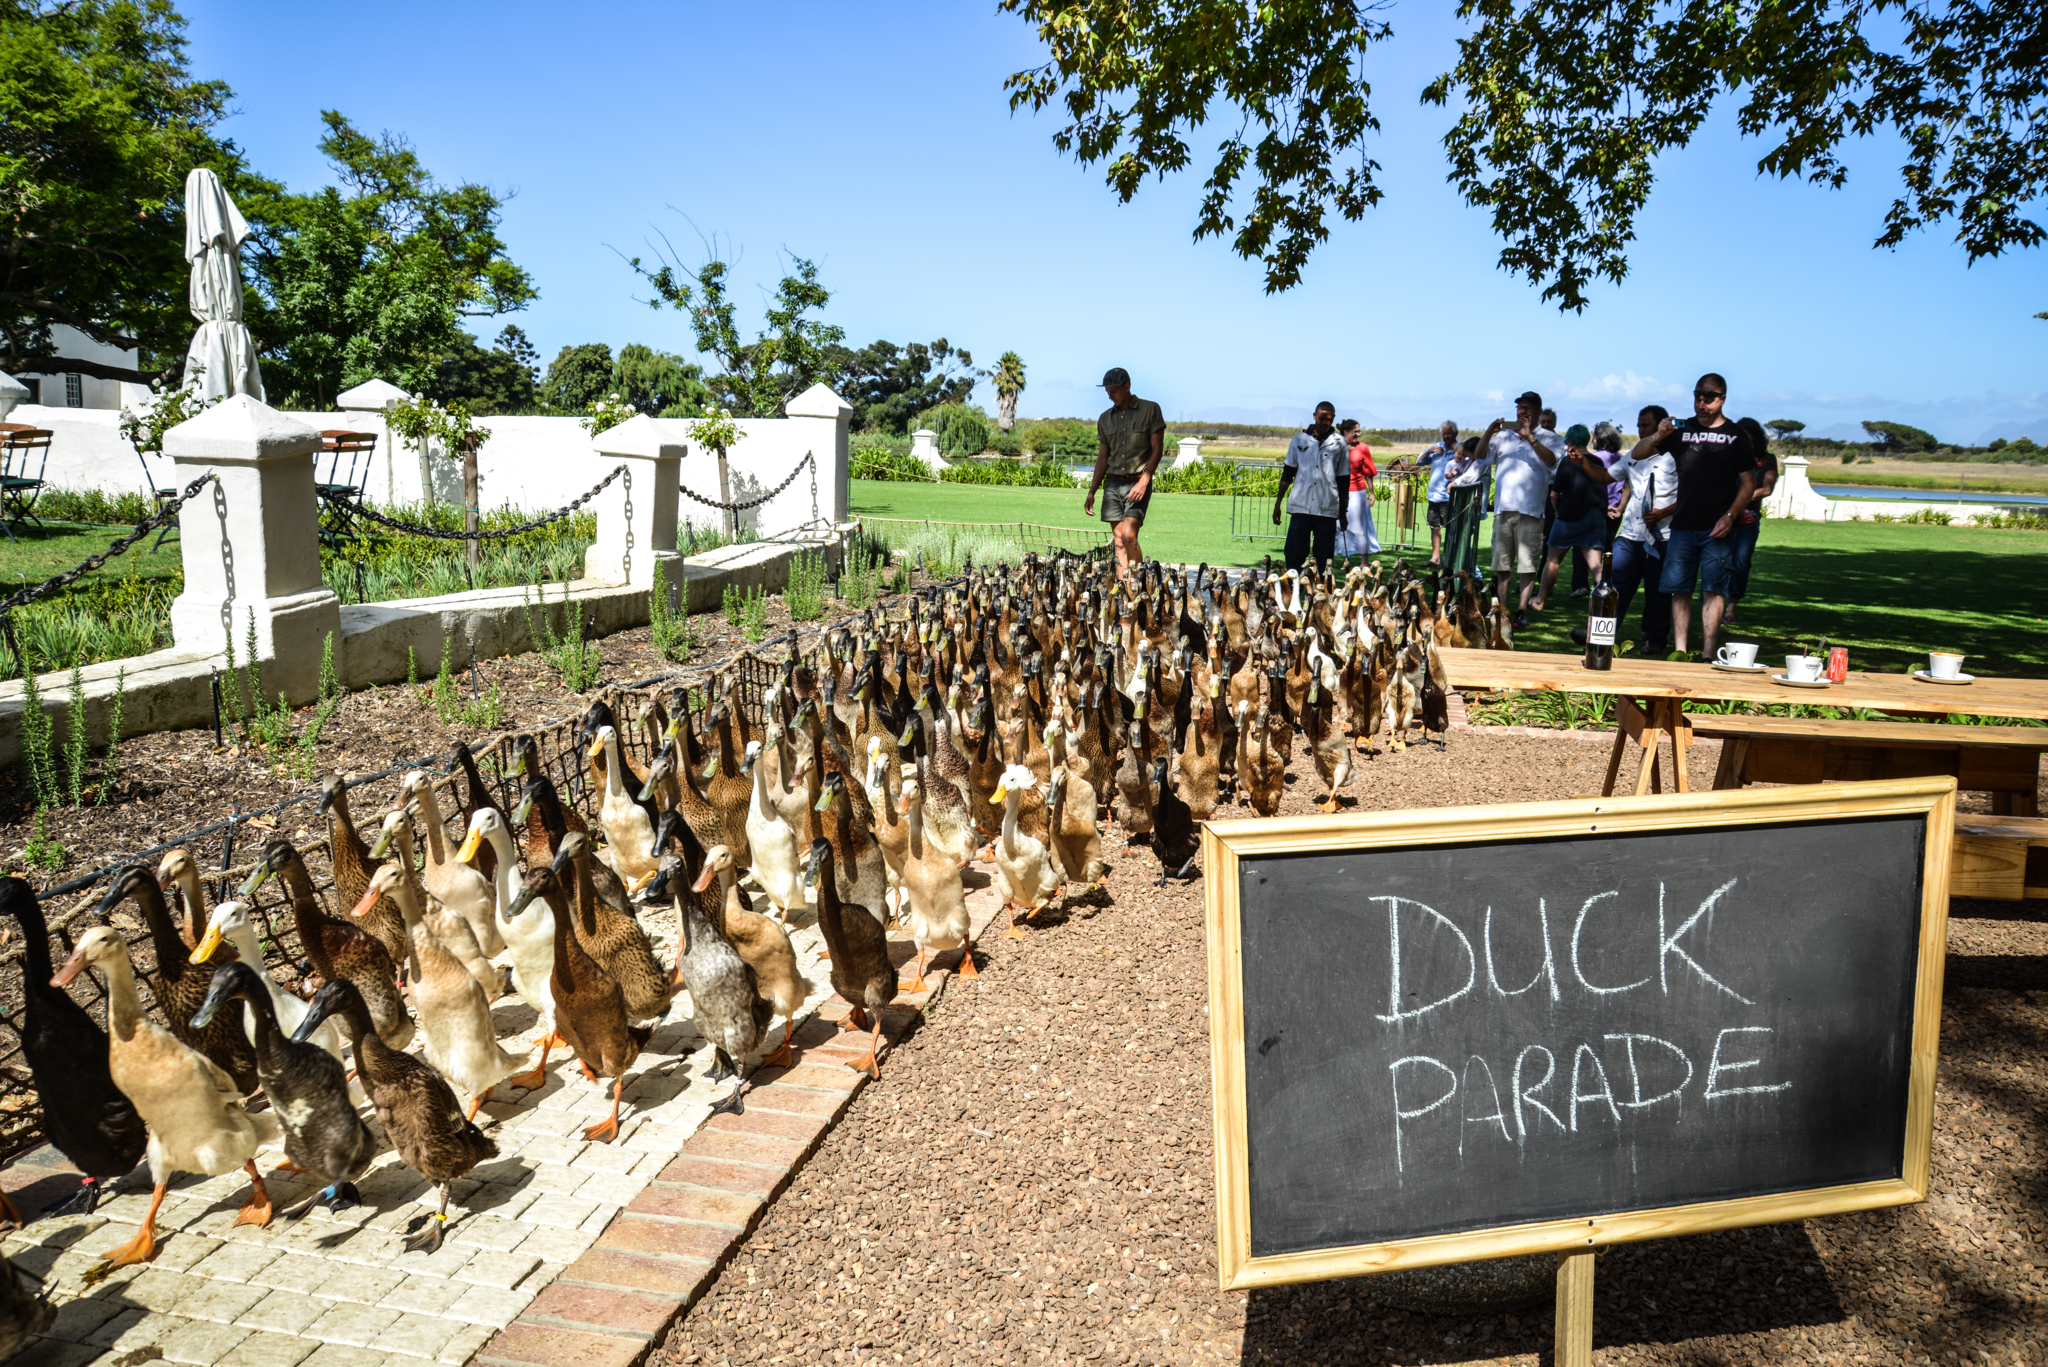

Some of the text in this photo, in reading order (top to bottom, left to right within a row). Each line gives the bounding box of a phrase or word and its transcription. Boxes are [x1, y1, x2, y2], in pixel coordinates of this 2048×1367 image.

[1682, 432, 1737, 444] BADBOY
[1594, 620, 1614, 633] 100
[1368, 877, 1756, 1022] DUCK
[1389, 1026, 1793, 1173] PARADE
